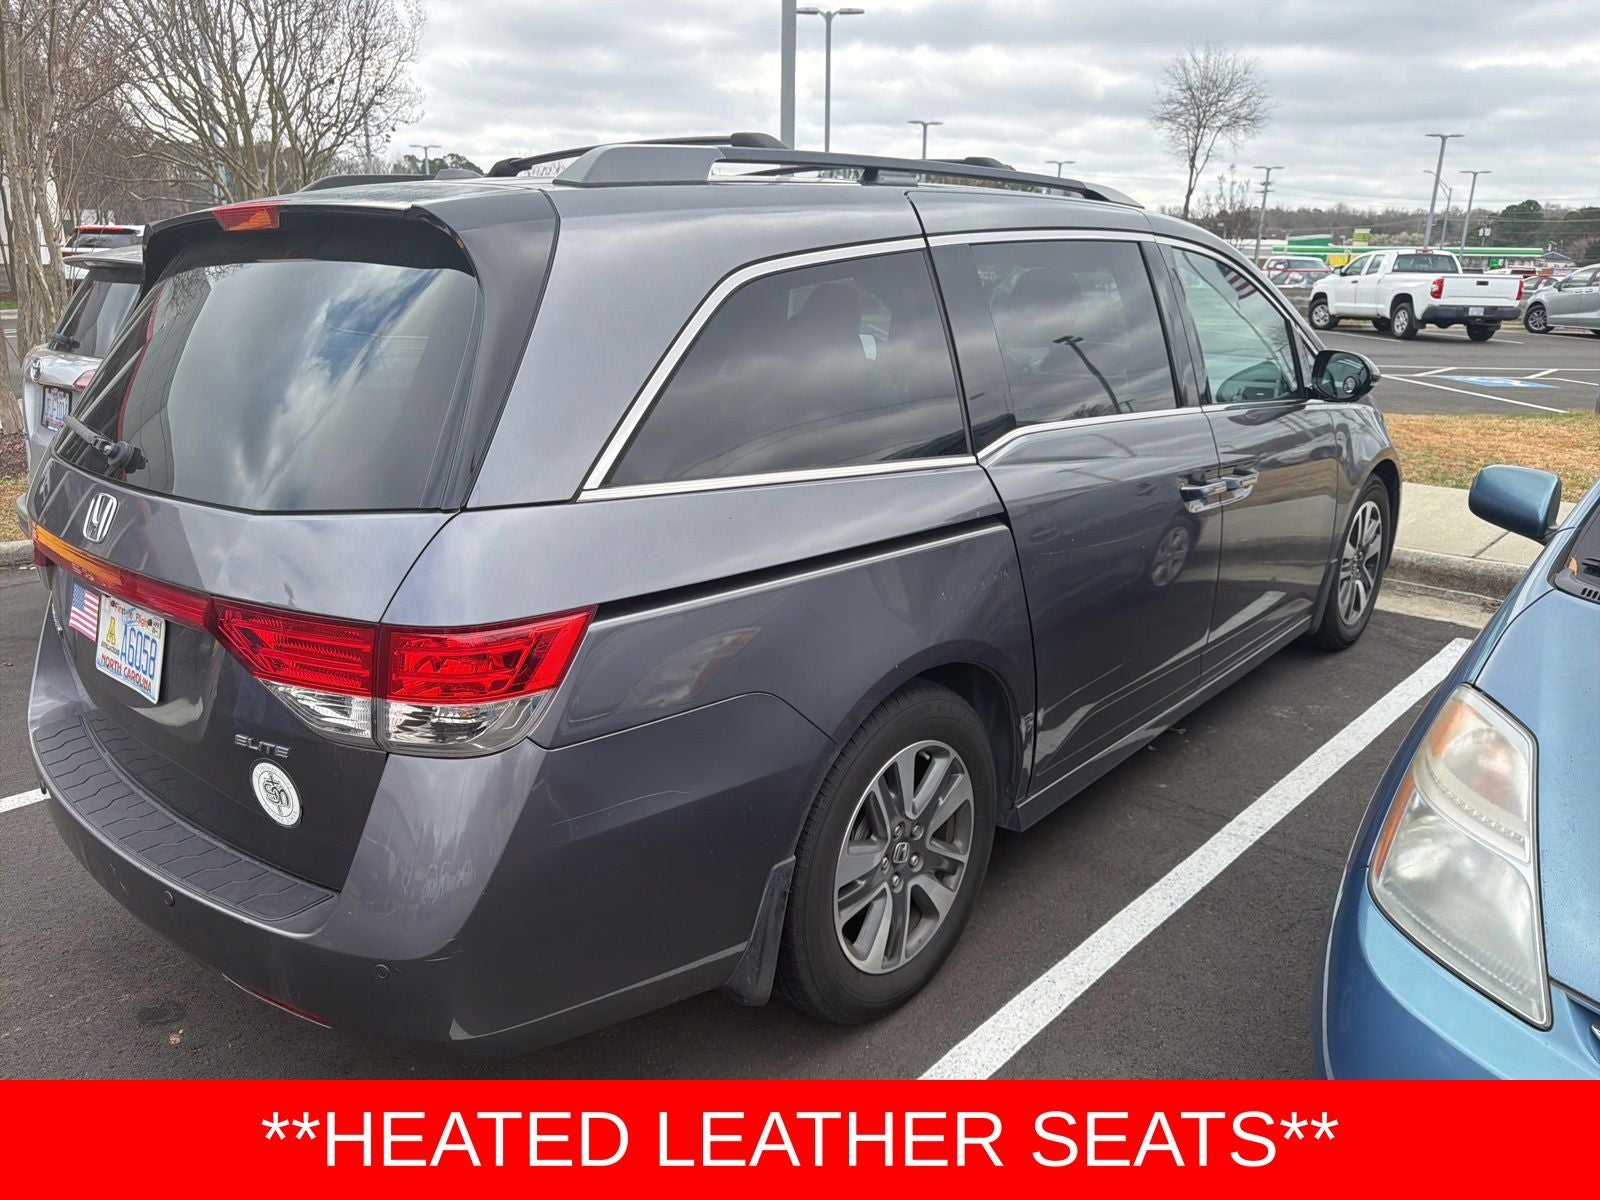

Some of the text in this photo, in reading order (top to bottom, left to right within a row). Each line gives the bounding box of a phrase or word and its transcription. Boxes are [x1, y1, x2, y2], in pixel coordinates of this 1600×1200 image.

[101, 654, 151, 691] NORTH CAROLINA
[234, 734, 291, 759] ELITE
